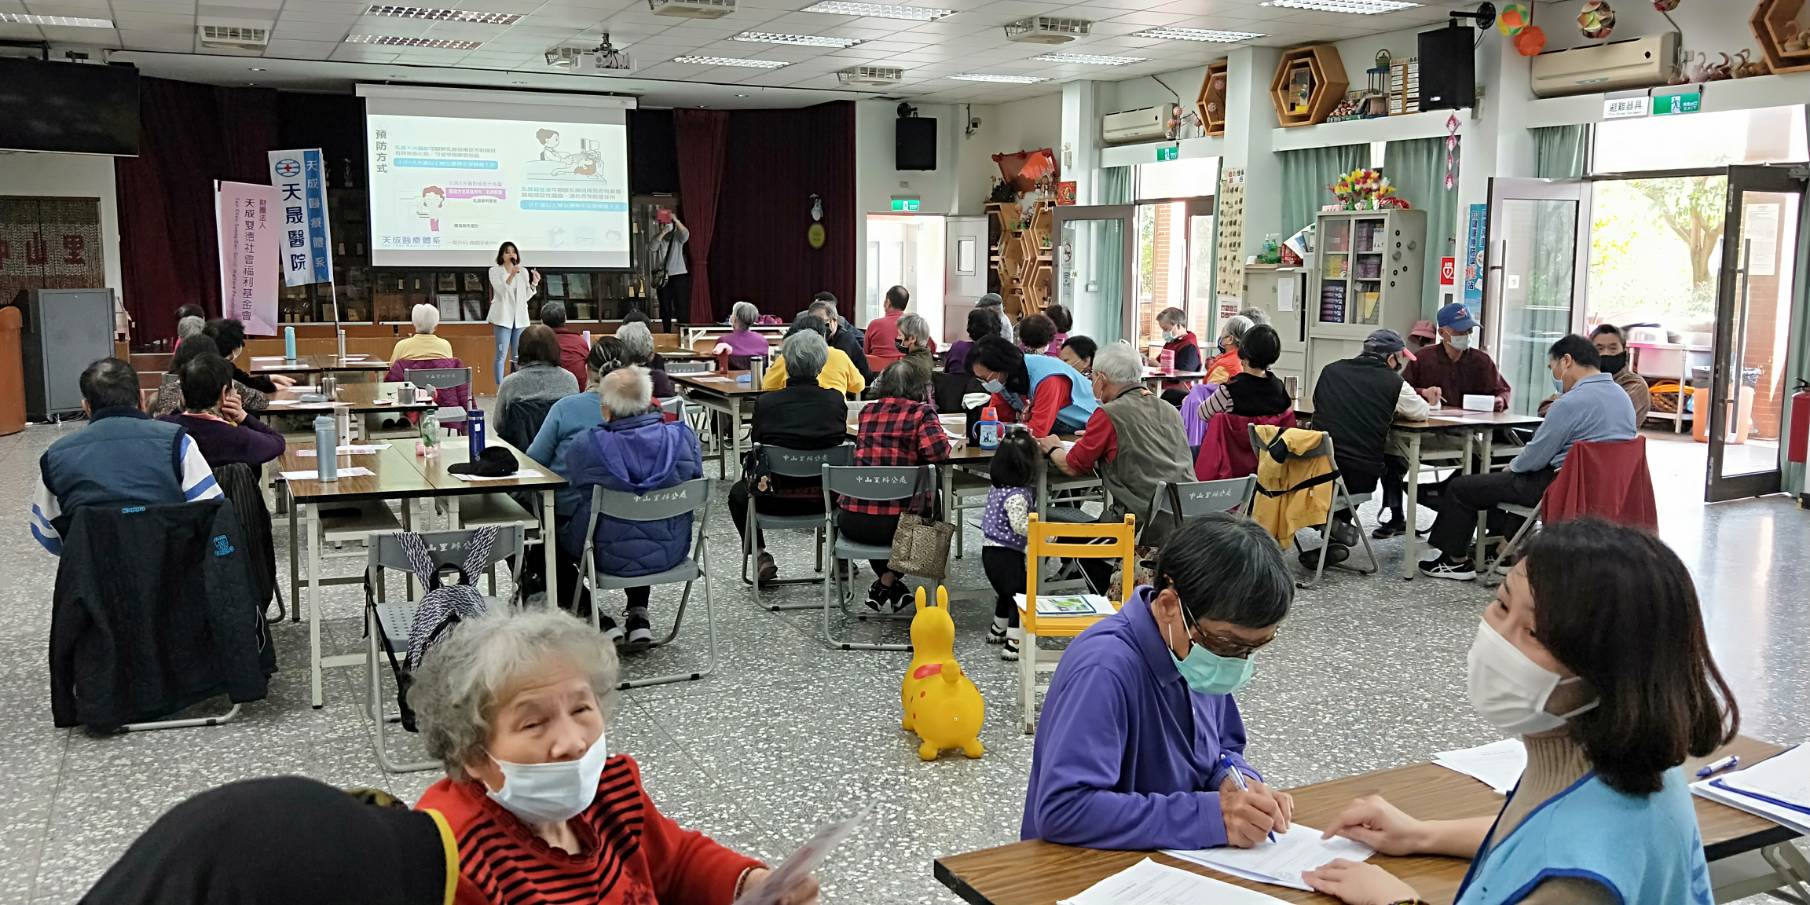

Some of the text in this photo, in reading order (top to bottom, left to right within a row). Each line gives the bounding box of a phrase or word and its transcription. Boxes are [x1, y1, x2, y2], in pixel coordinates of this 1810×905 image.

[376, 130, 387, 173] 預防方式
[282, 183, 306, 271] 天晟醫院
